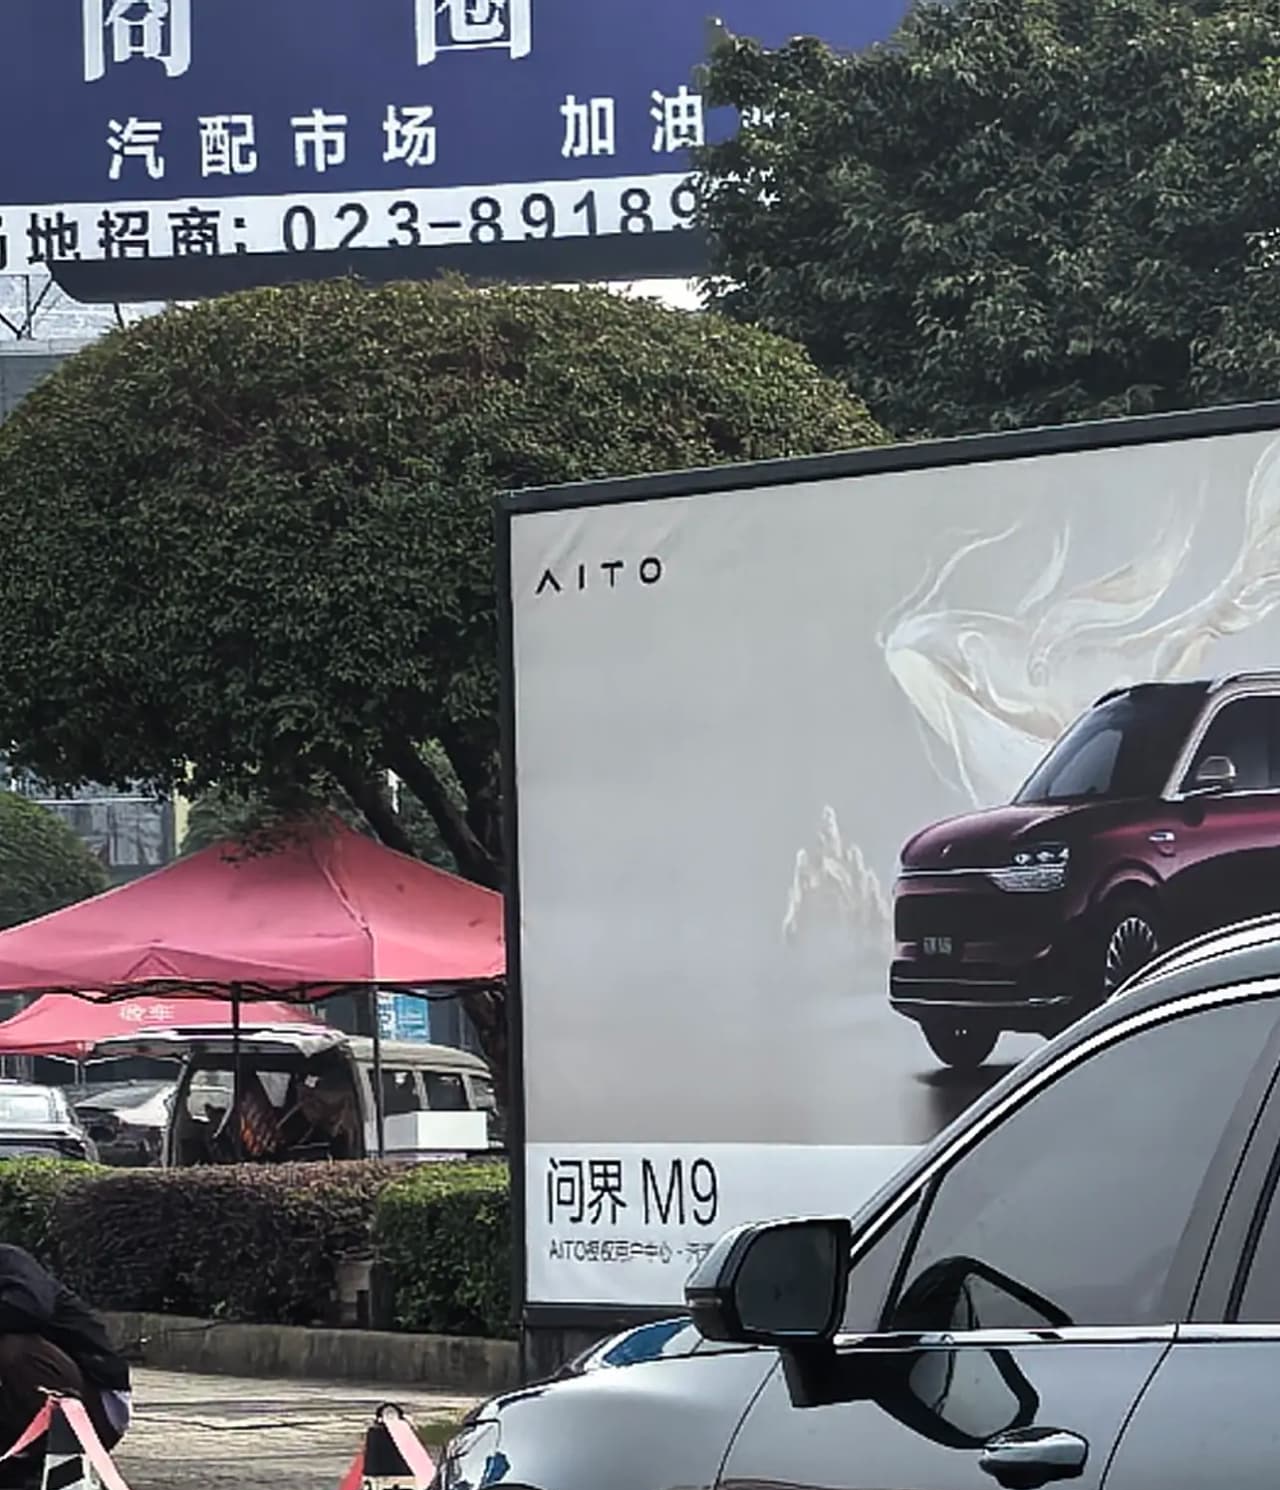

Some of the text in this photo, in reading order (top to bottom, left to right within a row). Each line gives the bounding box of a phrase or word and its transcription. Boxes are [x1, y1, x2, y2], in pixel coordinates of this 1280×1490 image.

[108, 104, 437, 180] 汽配市场
[535, 556, 662, 595] AITO
[547, 1157, 717, 1226] 问界 M9
